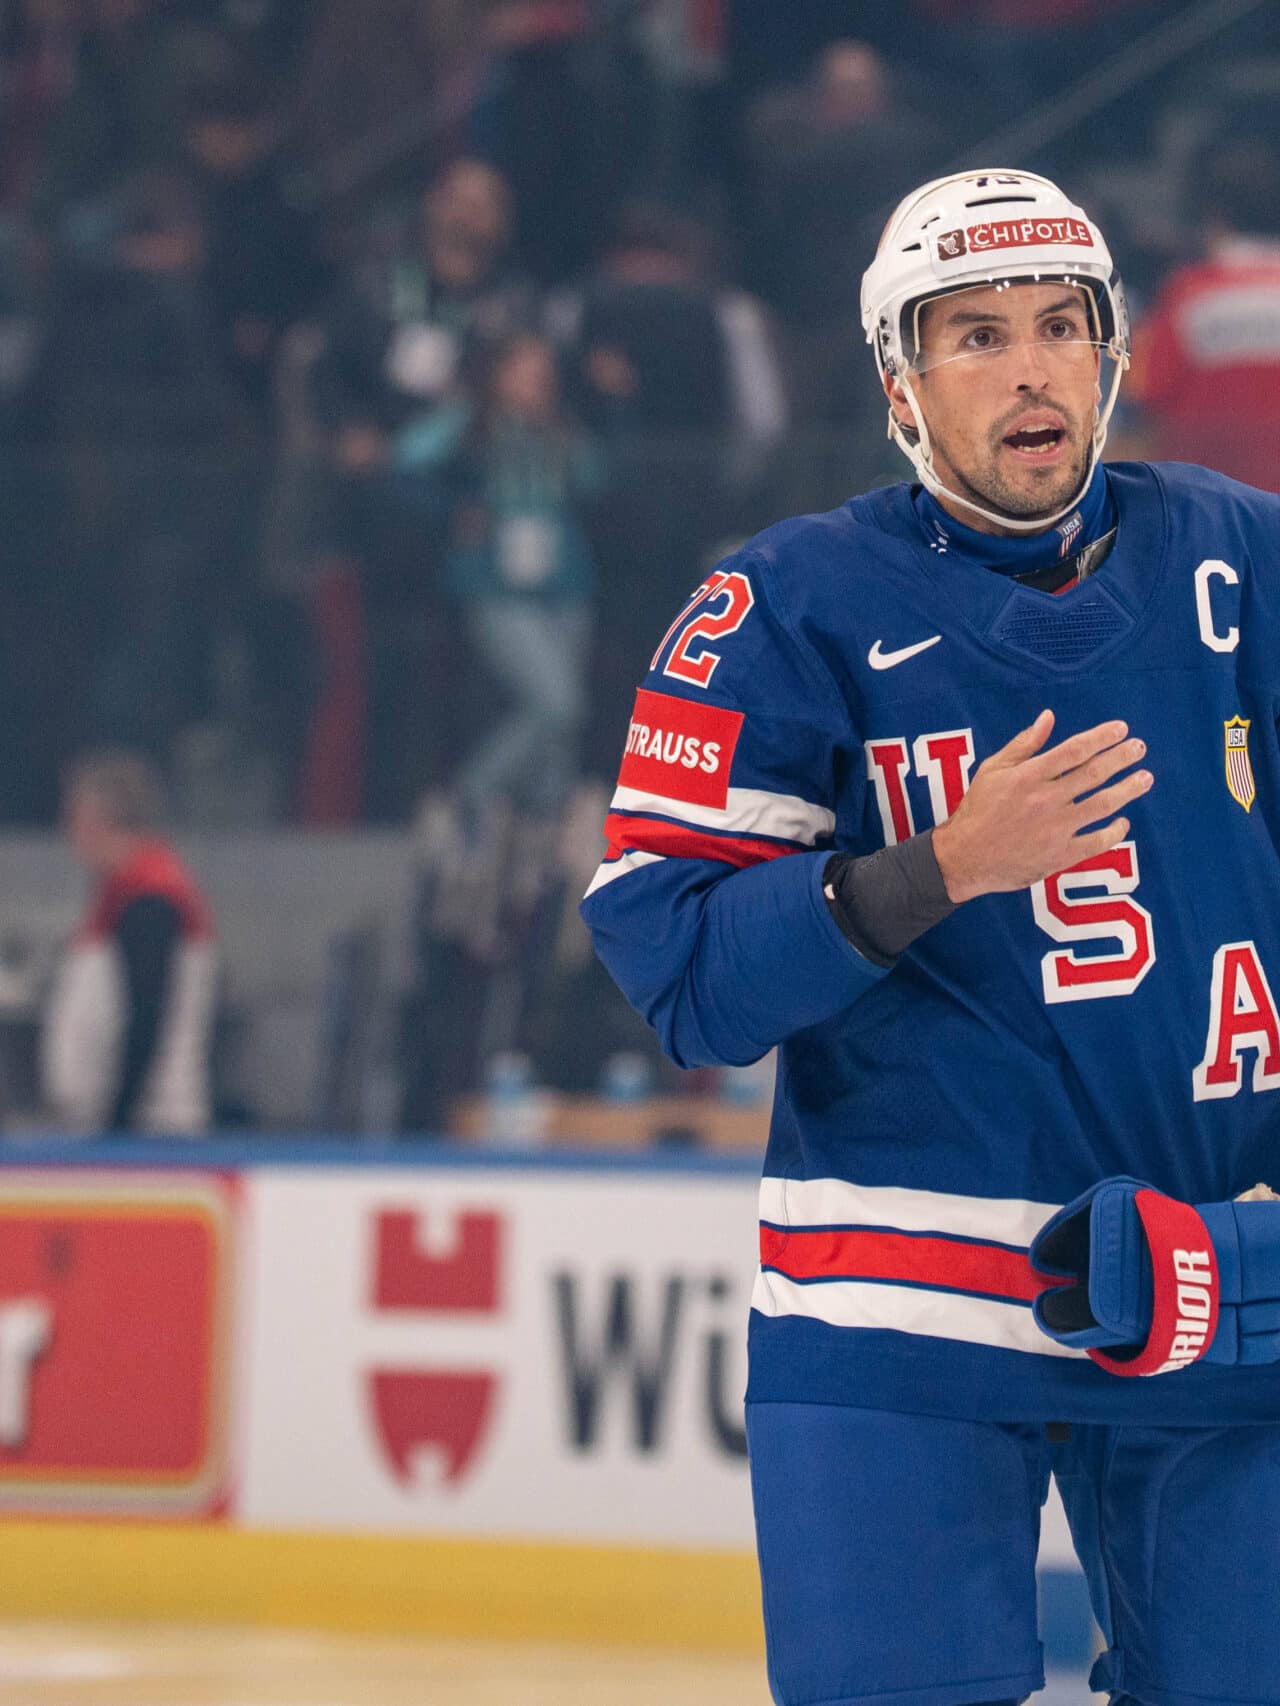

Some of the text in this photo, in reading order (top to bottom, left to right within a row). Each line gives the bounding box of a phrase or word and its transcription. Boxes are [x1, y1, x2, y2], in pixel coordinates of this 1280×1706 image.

[973, 224, 1089, 247] CHIPOTLE
[1062, 518, 1081, 536] USA
[1194, 559, 1240, 653] C
[650, 570, 755, 689] 72
[1229, 729, 1244, 745] USA
